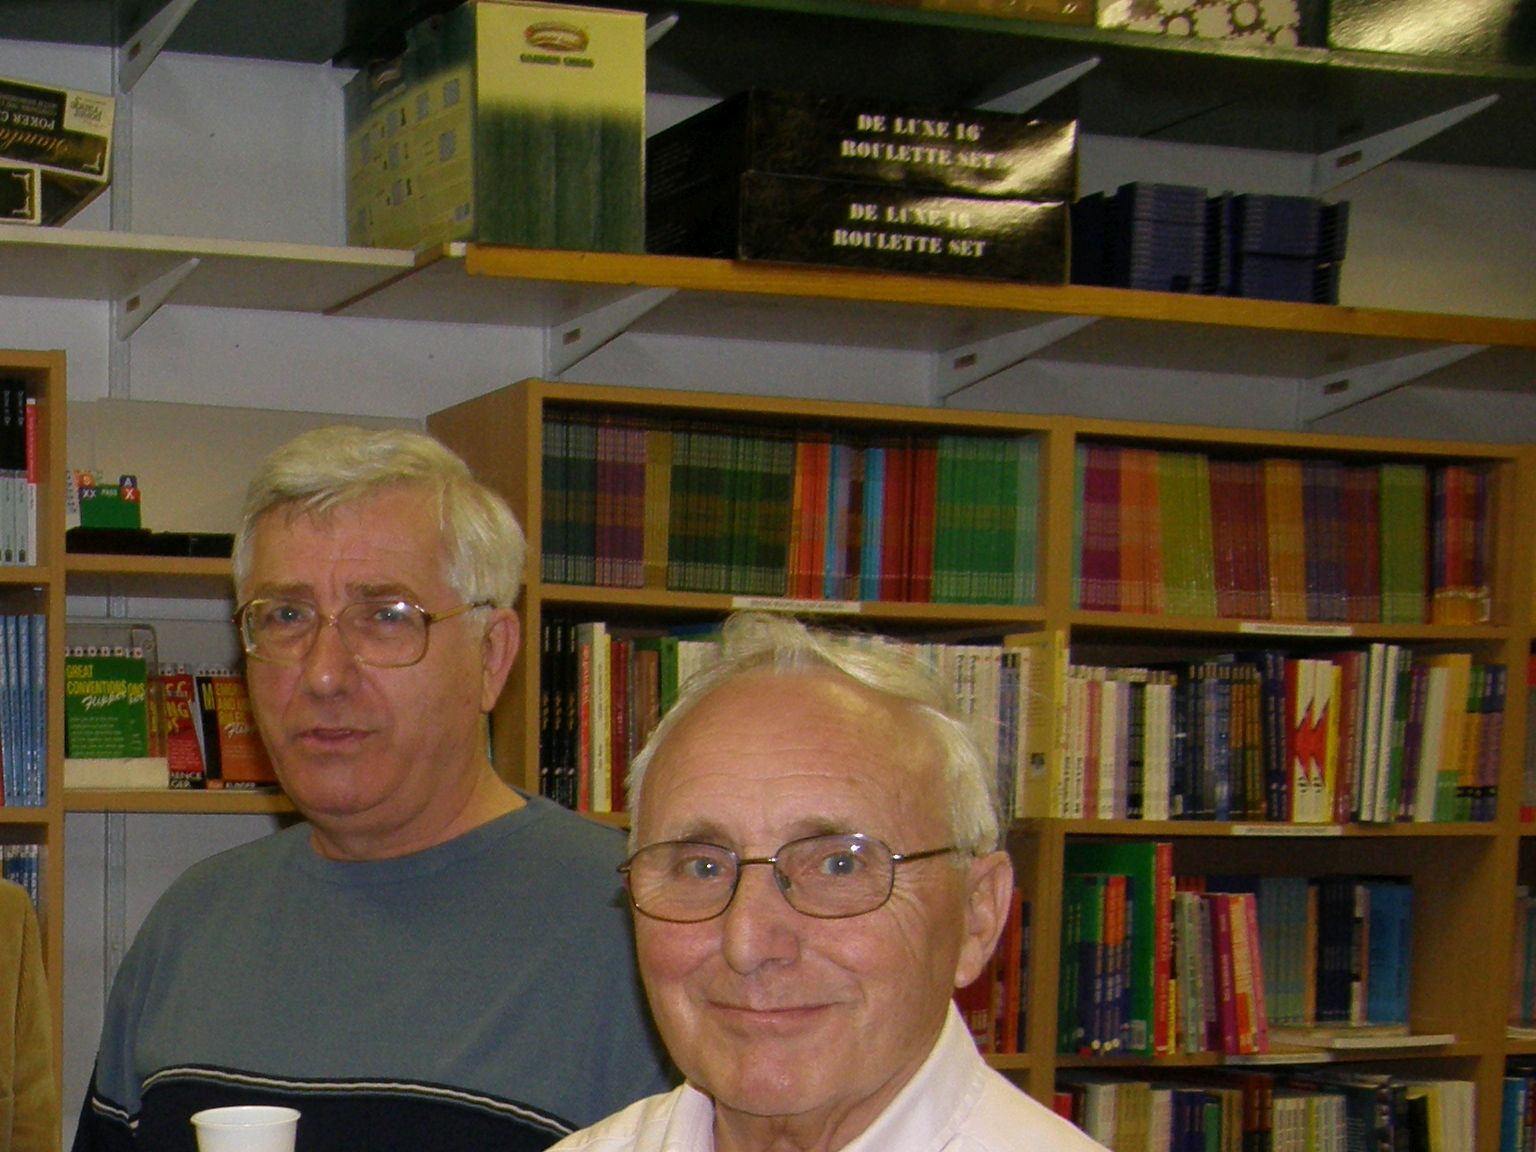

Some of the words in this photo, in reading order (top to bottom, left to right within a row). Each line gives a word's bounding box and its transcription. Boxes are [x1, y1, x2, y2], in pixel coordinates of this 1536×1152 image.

[12, 112, 55, 130] POKER
[857, 113, 886, 132] DE
[893, 117, 950, 138] LUXE
[840, 139, 952, 166] ROULETTE
[955, 151, 994, 169] SET
[849, 202, 878, 221] DE
[832, 229, 943, 254] ROULETTE
[948, 239, 986, 257] SET
[124, 477, 134, 487] A
[82, 488, 97, 499] XX
[101, 488, 118, 496] PASS
[125, 488, 136, 500] X
[66, 664, 93, 678] GREAT
[67, 680, 126, 695] CONVENTIONS
